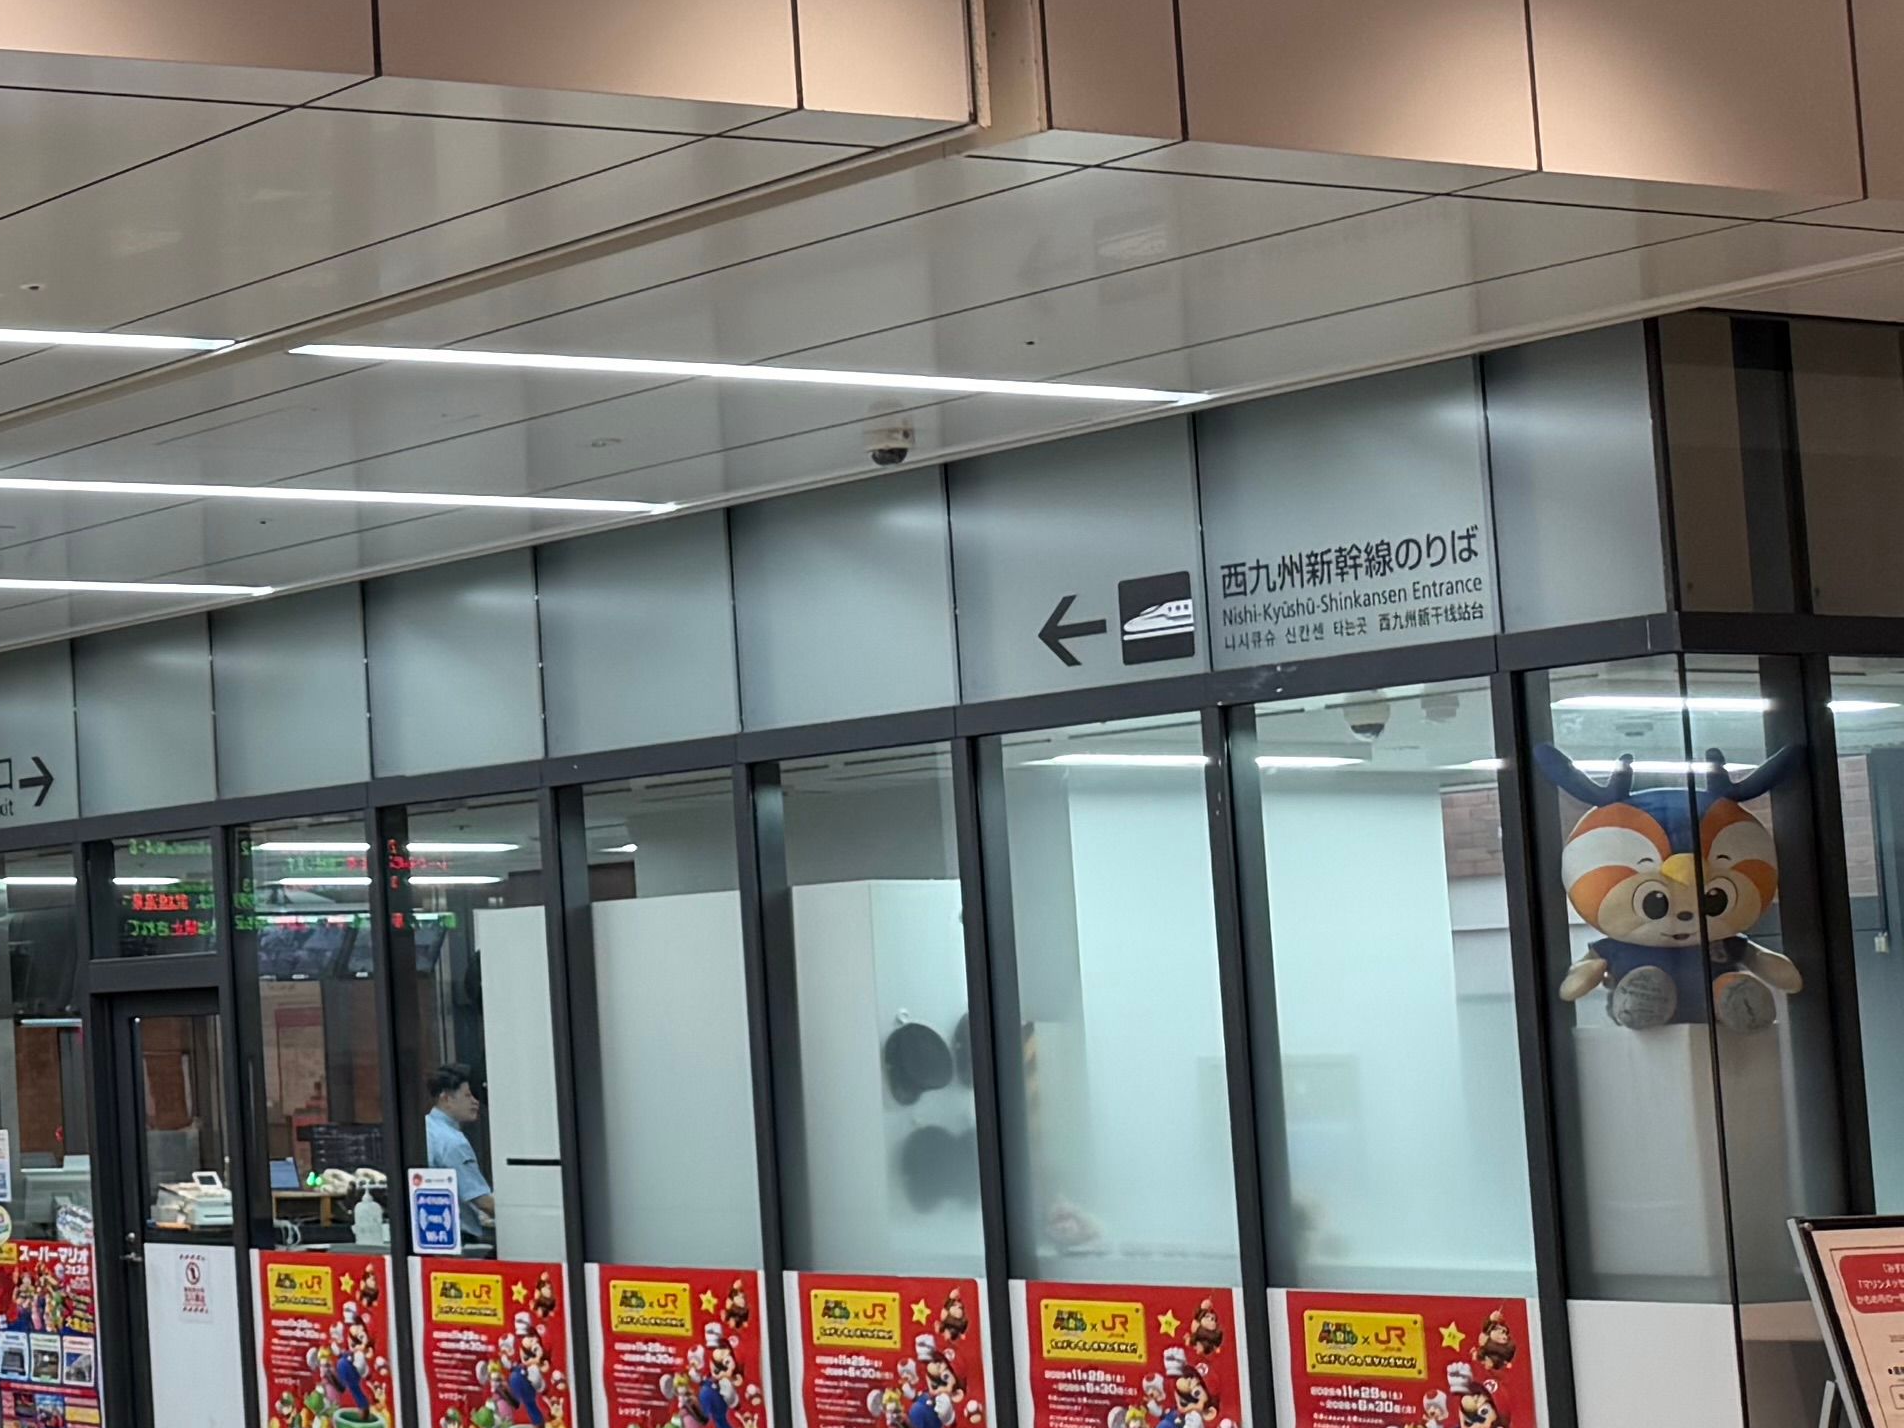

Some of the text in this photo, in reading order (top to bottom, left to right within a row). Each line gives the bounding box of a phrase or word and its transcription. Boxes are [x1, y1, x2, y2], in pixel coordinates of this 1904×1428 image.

[1220, 524, 1481, 599] 西九州新幹線のりば
[1222, 575, 1483, 627] Nishi-Kyūshū-Shinkansen Entrance
[1378, 601, 1484, 633] 西九州新干线站台
[657, 1293, 679, 1310] JR
[863, 1302, 887, 1321] JR
[1101, 1313, 1129, 1334] JR
[1374, 1325, 1406, 1346] JR
